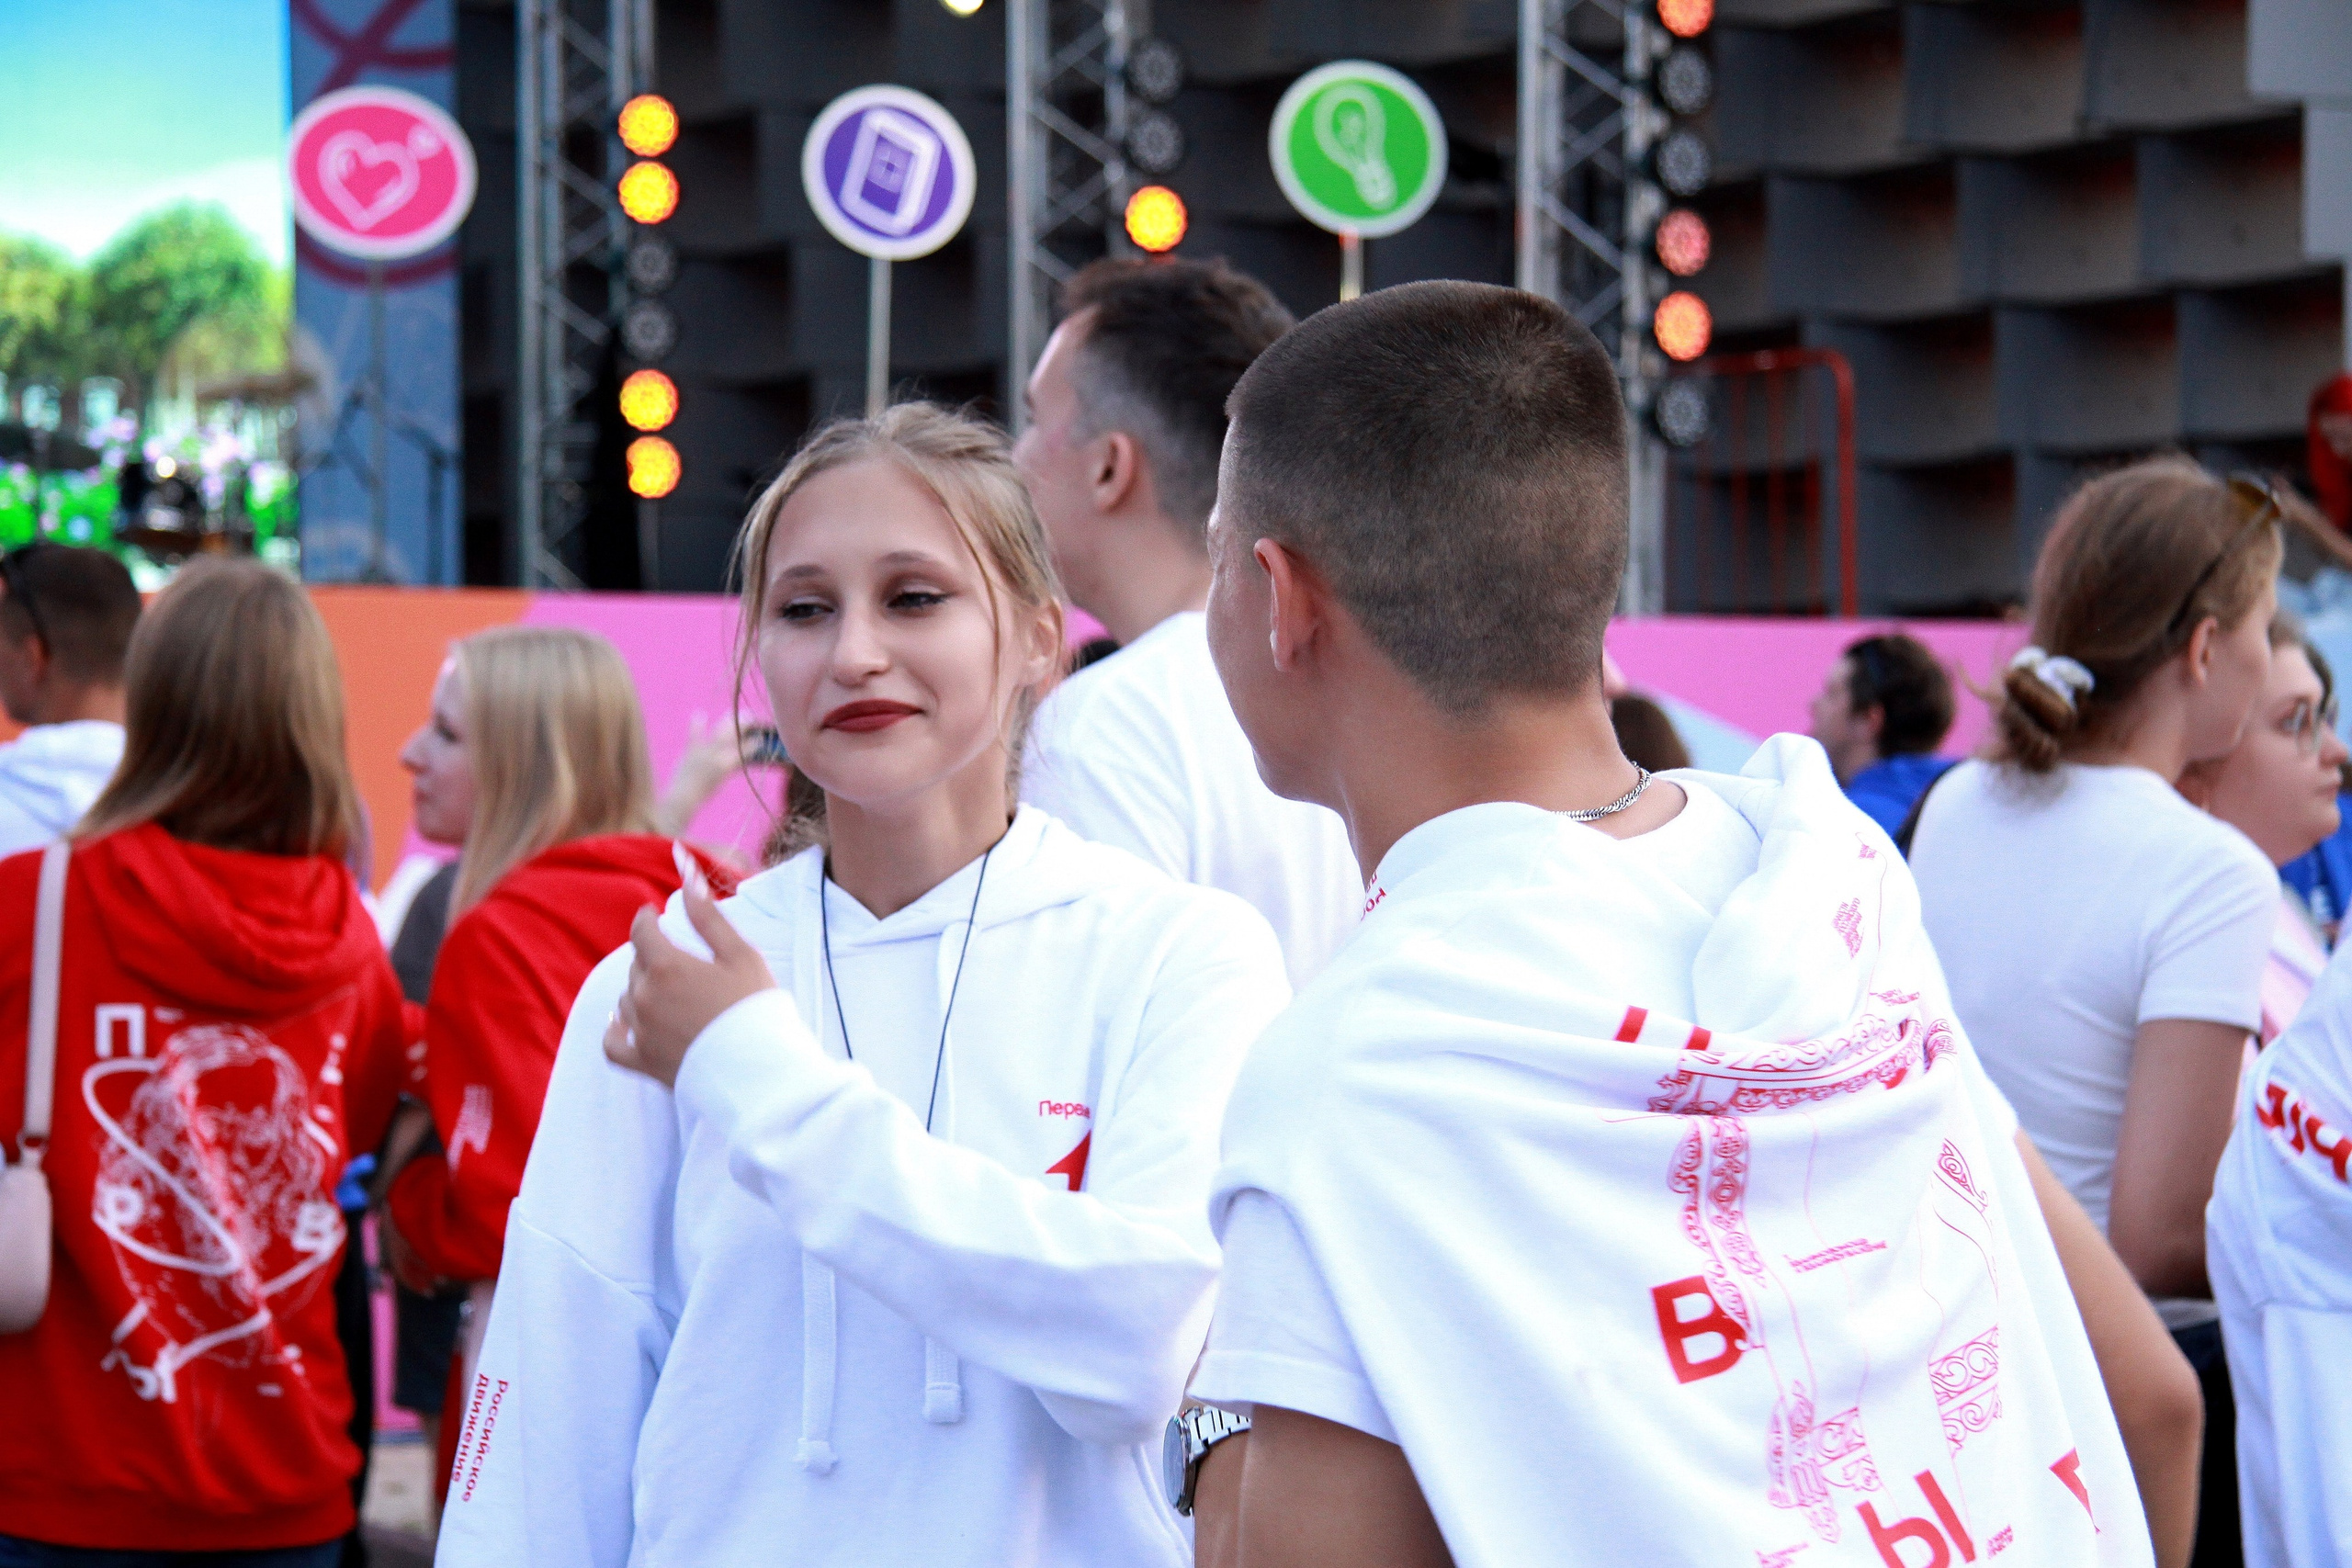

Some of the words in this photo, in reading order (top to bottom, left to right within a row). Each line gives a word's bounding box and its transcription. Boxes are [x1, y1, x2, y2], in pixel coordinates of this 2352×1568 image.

[1649, 1274, 1748, 1384] В
[451, 1373, 490, 1482] Движение
[461, 1380, 509, 1502] Российское
